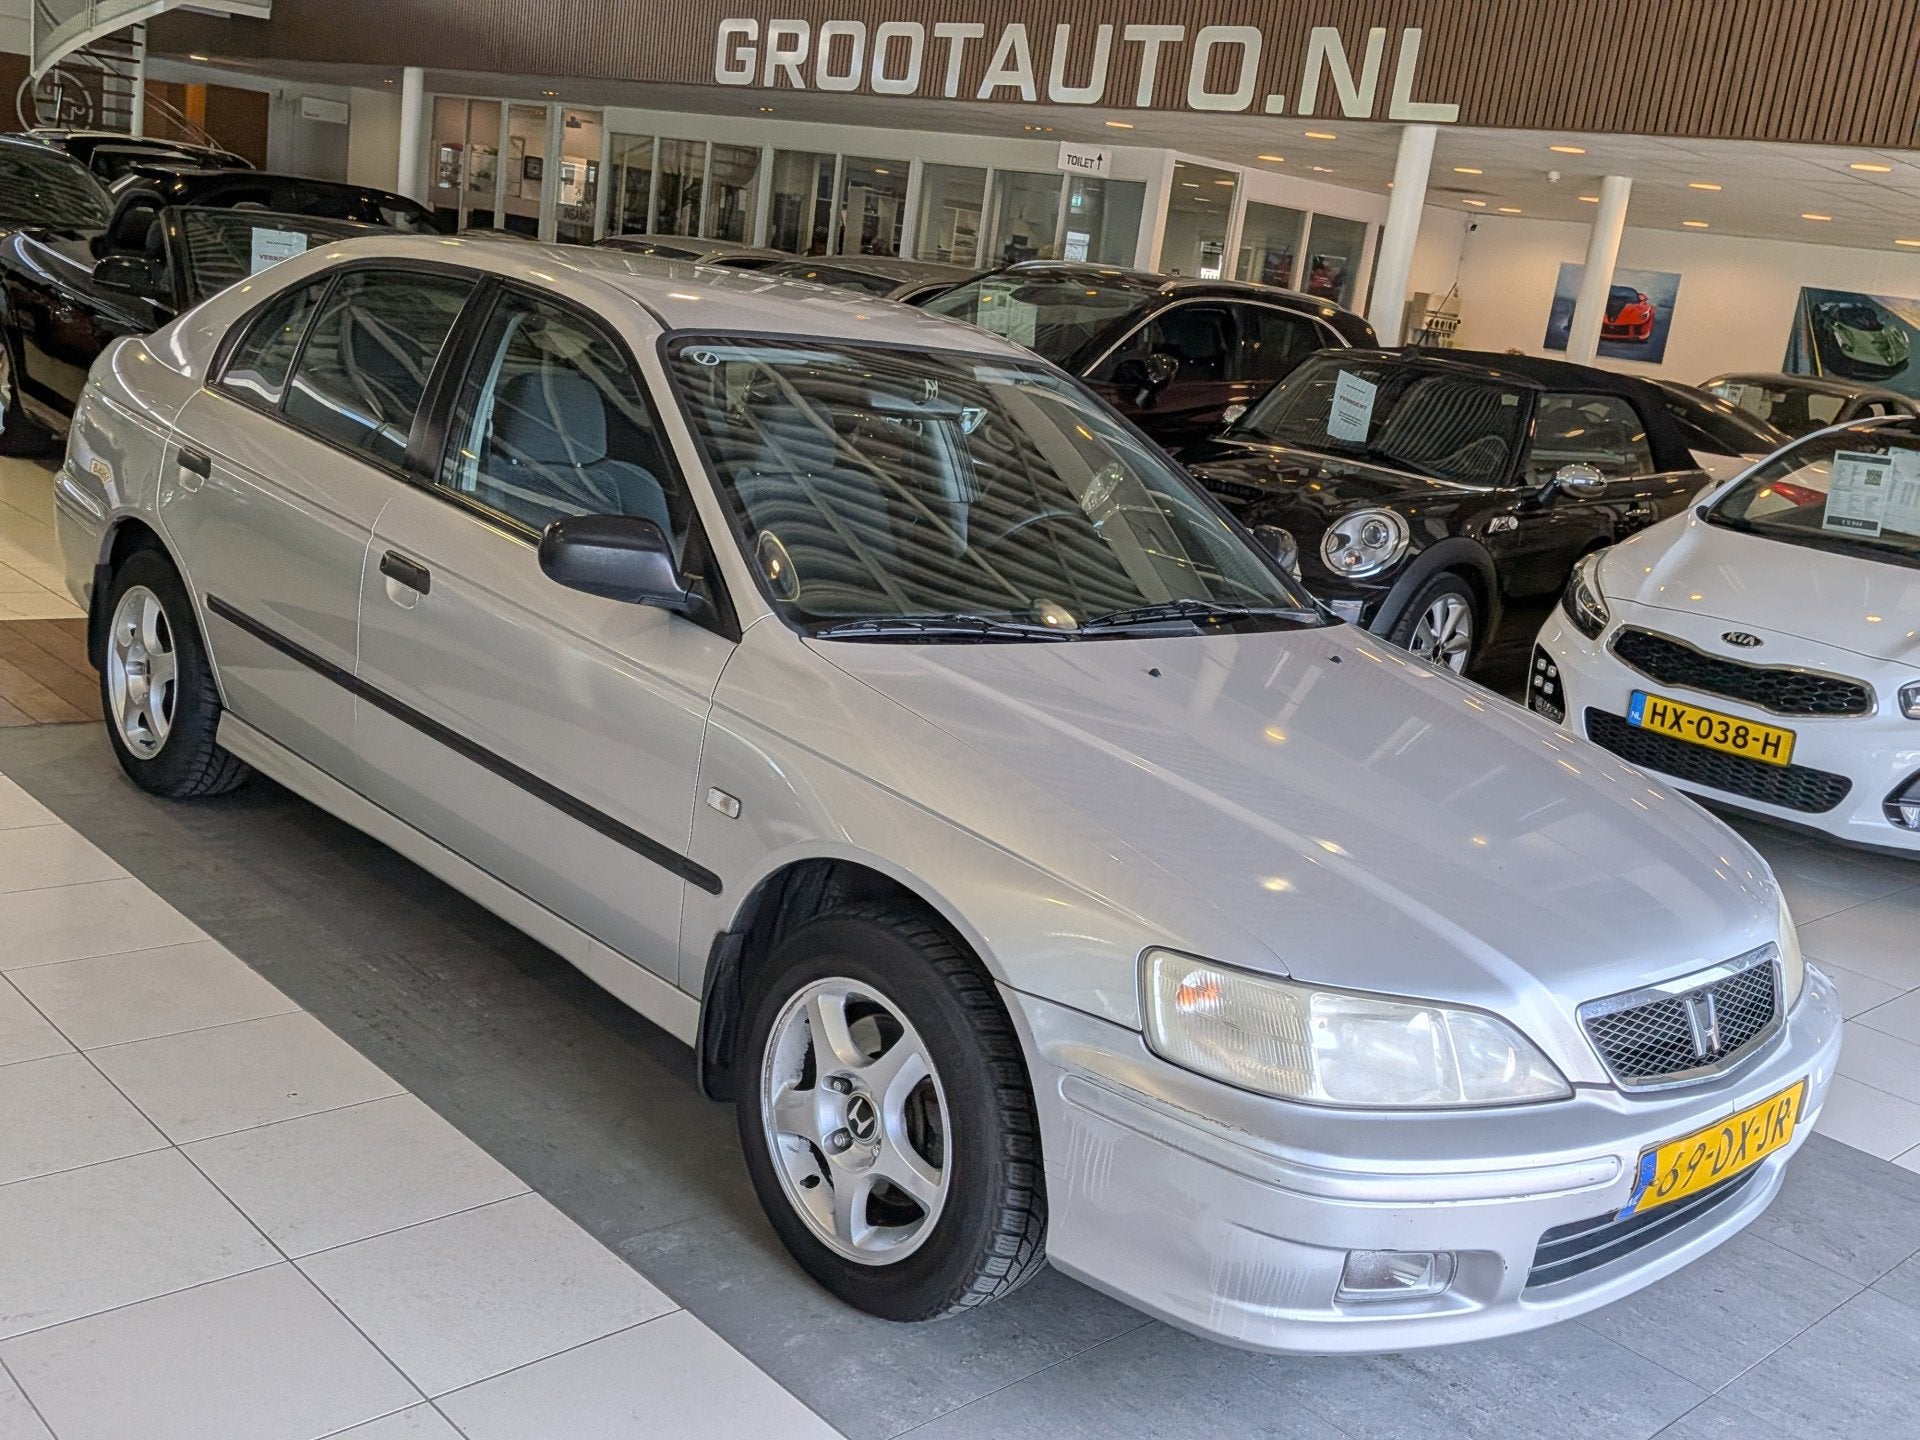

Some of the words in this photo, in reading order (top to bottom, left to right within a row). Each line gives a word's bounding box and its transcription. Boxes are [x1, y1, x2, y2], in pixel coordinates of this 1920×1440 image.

[715, 18, 1459, 123] GROOTAUTO.NL
[1067, 153, 1095, 169] TOILET
[1726, 632, 1756, 646] KIA
[1630, 710, 1641, 721] NL
[1650, 702, 1782, 759] HX-038-H
[1657, 1097, 1792, 1198] 69-DX-JR
